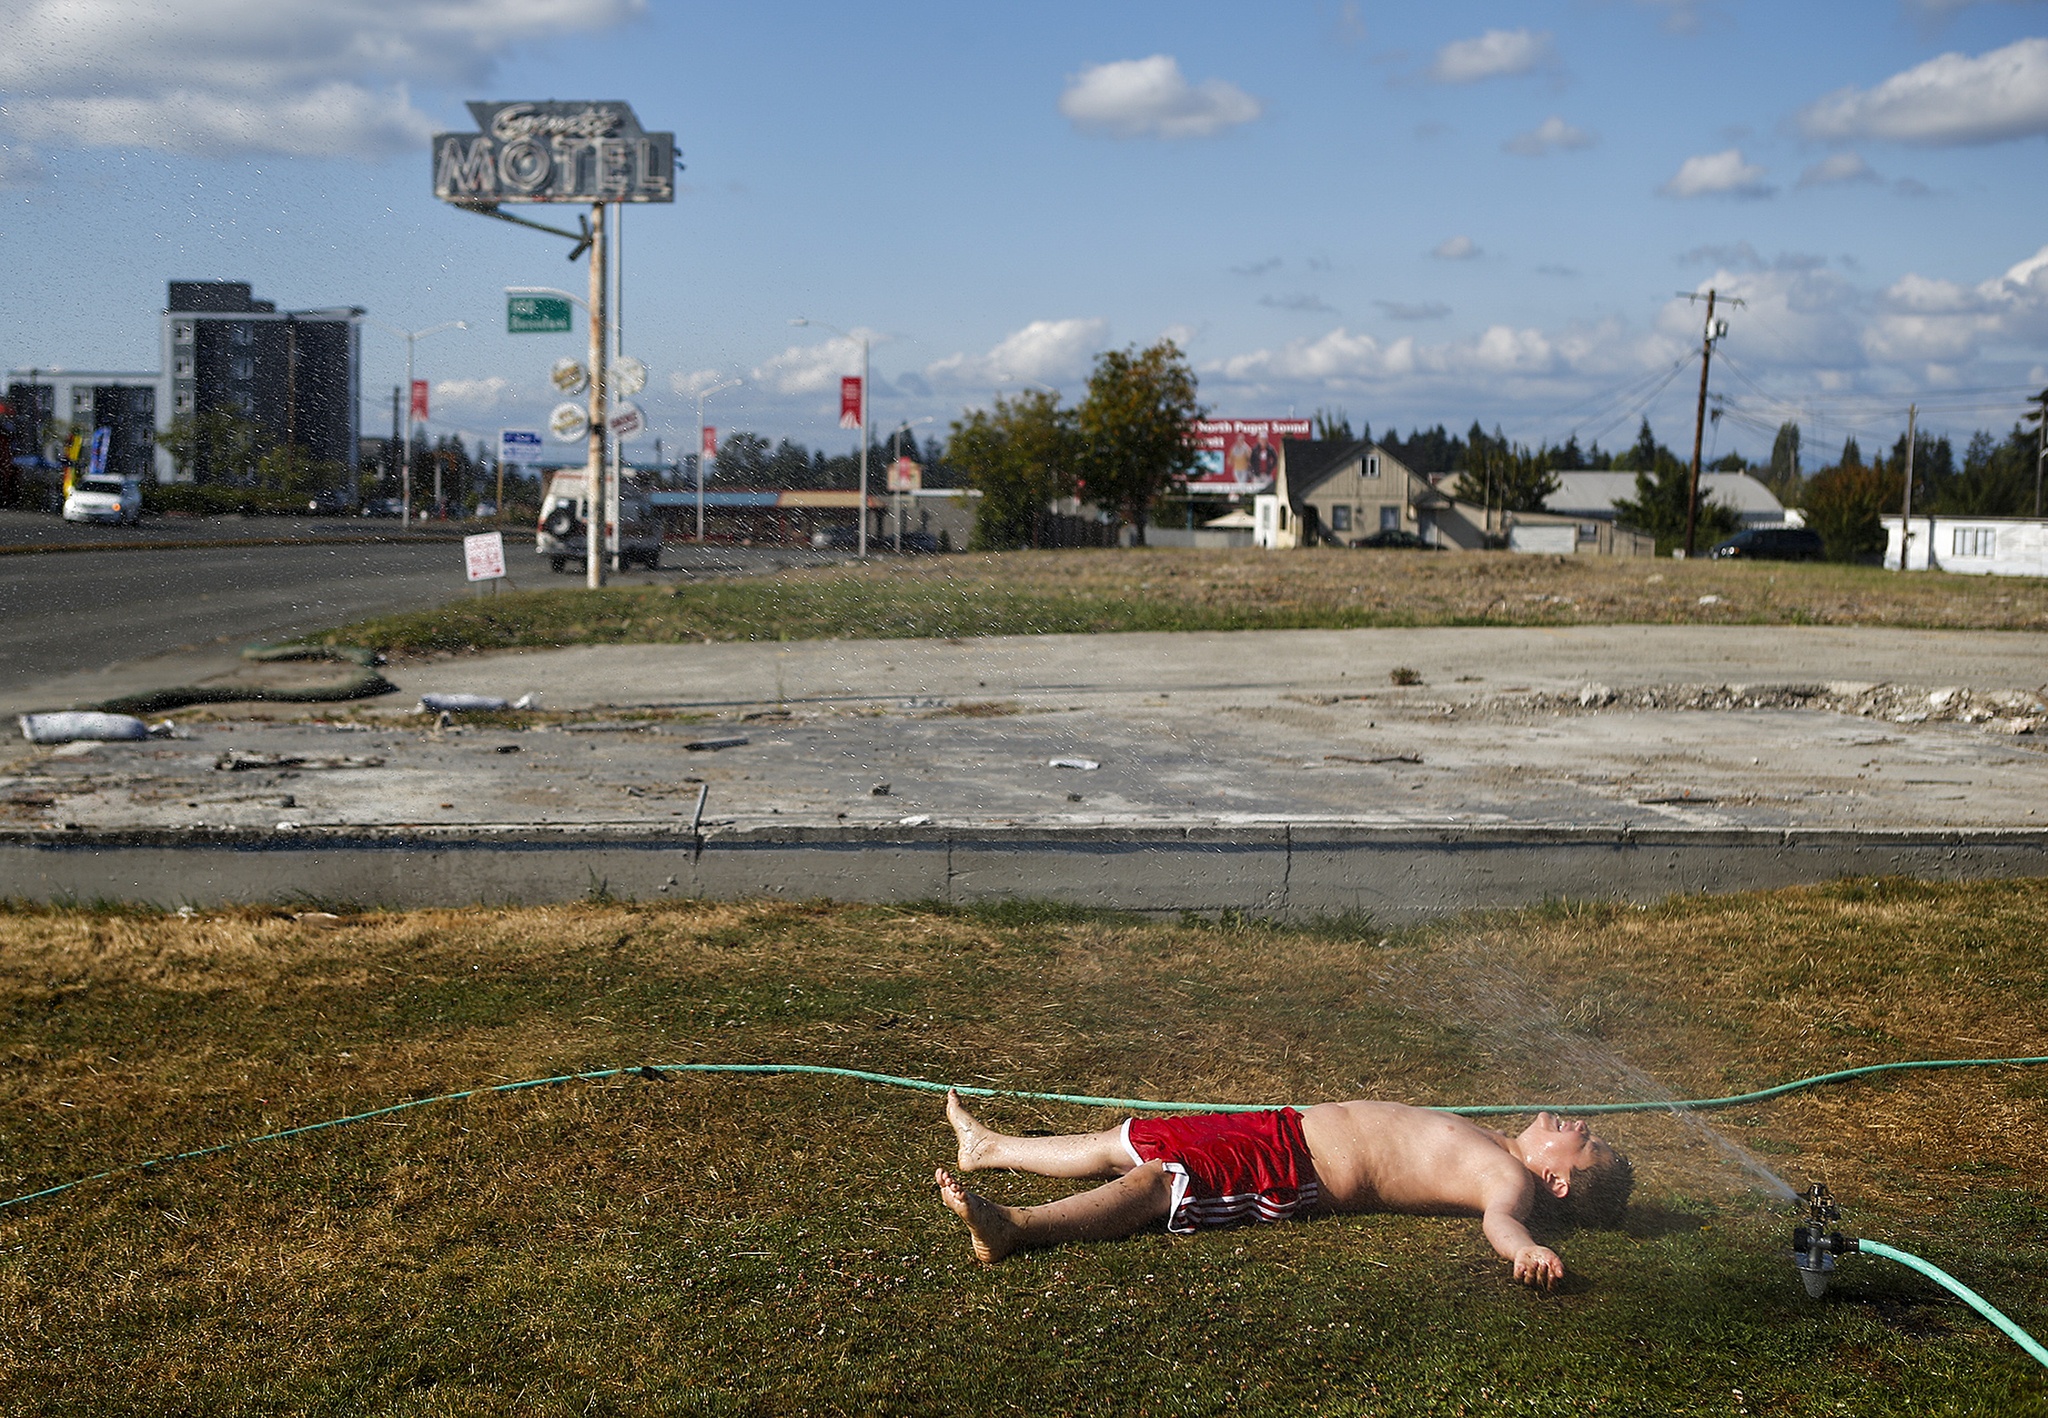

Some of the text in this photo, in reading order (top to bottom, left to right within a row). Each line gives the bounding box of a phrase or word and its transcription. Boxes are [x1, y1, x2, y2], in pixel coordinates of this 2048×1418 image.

[435, 136, 672, 196] MOTEL
[1197, 420, 1232, 433] North
[1234, 420, 1268, 436] Puget
[1272, 420, 1310, 433] Sound
